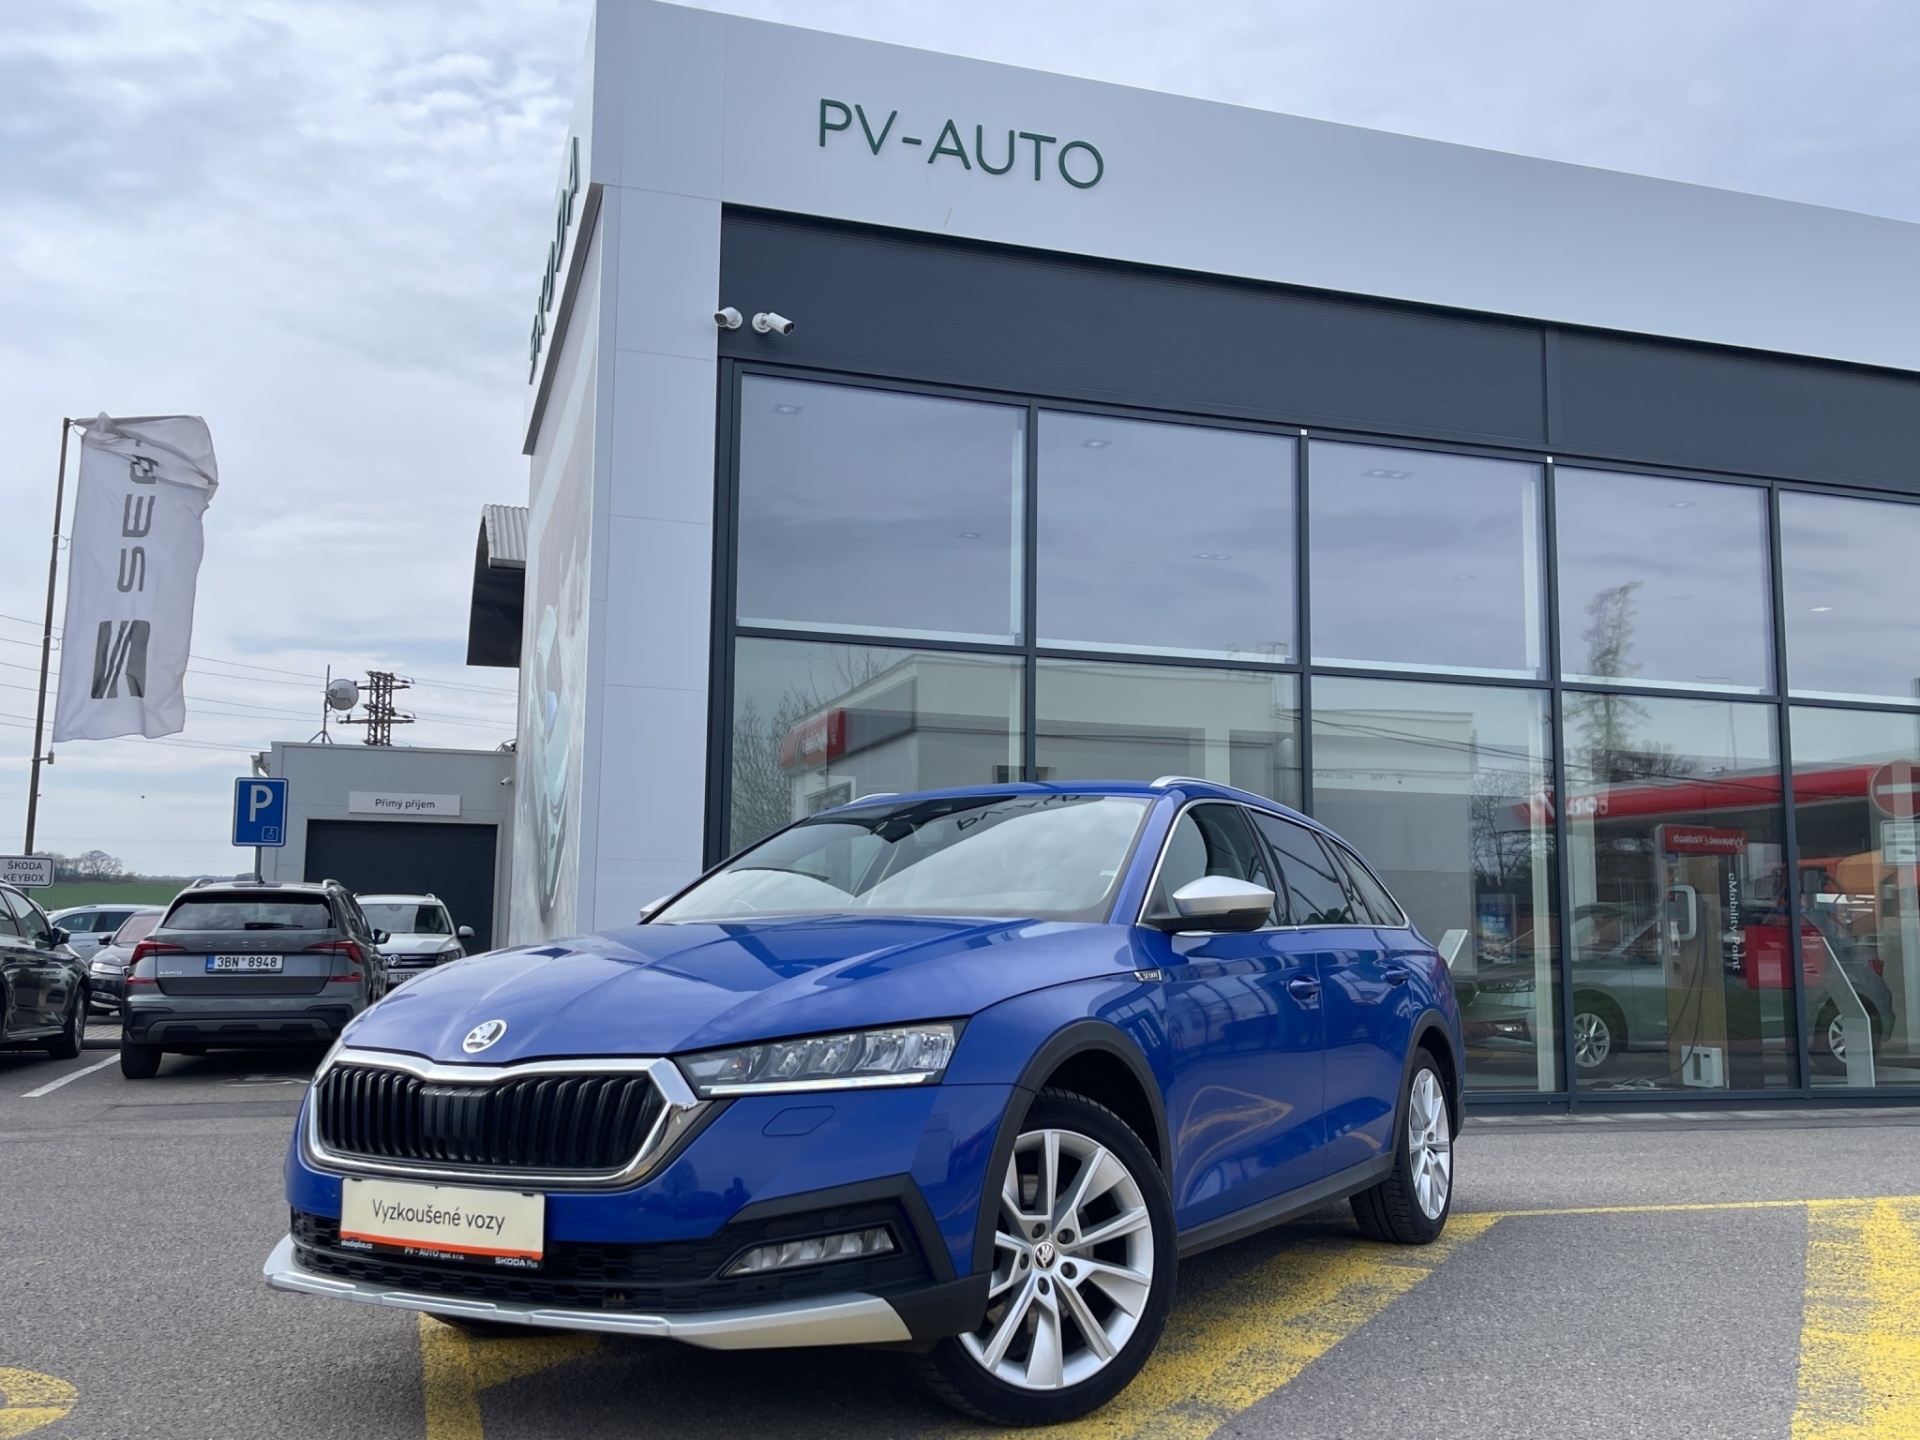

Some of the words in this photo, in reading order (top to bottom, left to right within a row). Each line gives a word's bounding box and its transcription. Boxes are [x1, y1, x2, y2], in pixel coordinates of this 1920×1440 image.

[819, 98, 1104, 189] PV-AUTO
[249, 785, 273, 822] P
[3, 873, 45, 882] KEYBOX
[7, 859, 43, 870] ŠKODA
[1728, 872, 1739, 933] eMobility
[217, 956, 240, 968] 3BN
[248, 956, 278, 968] 8948
[1731, 936, 1741, 970] Point
[372, 1198, 461, 1227] Vyzkoušené
[466, 1213, 506, 1236] vozy
[418, 1248, 439, 1257] AUTO
